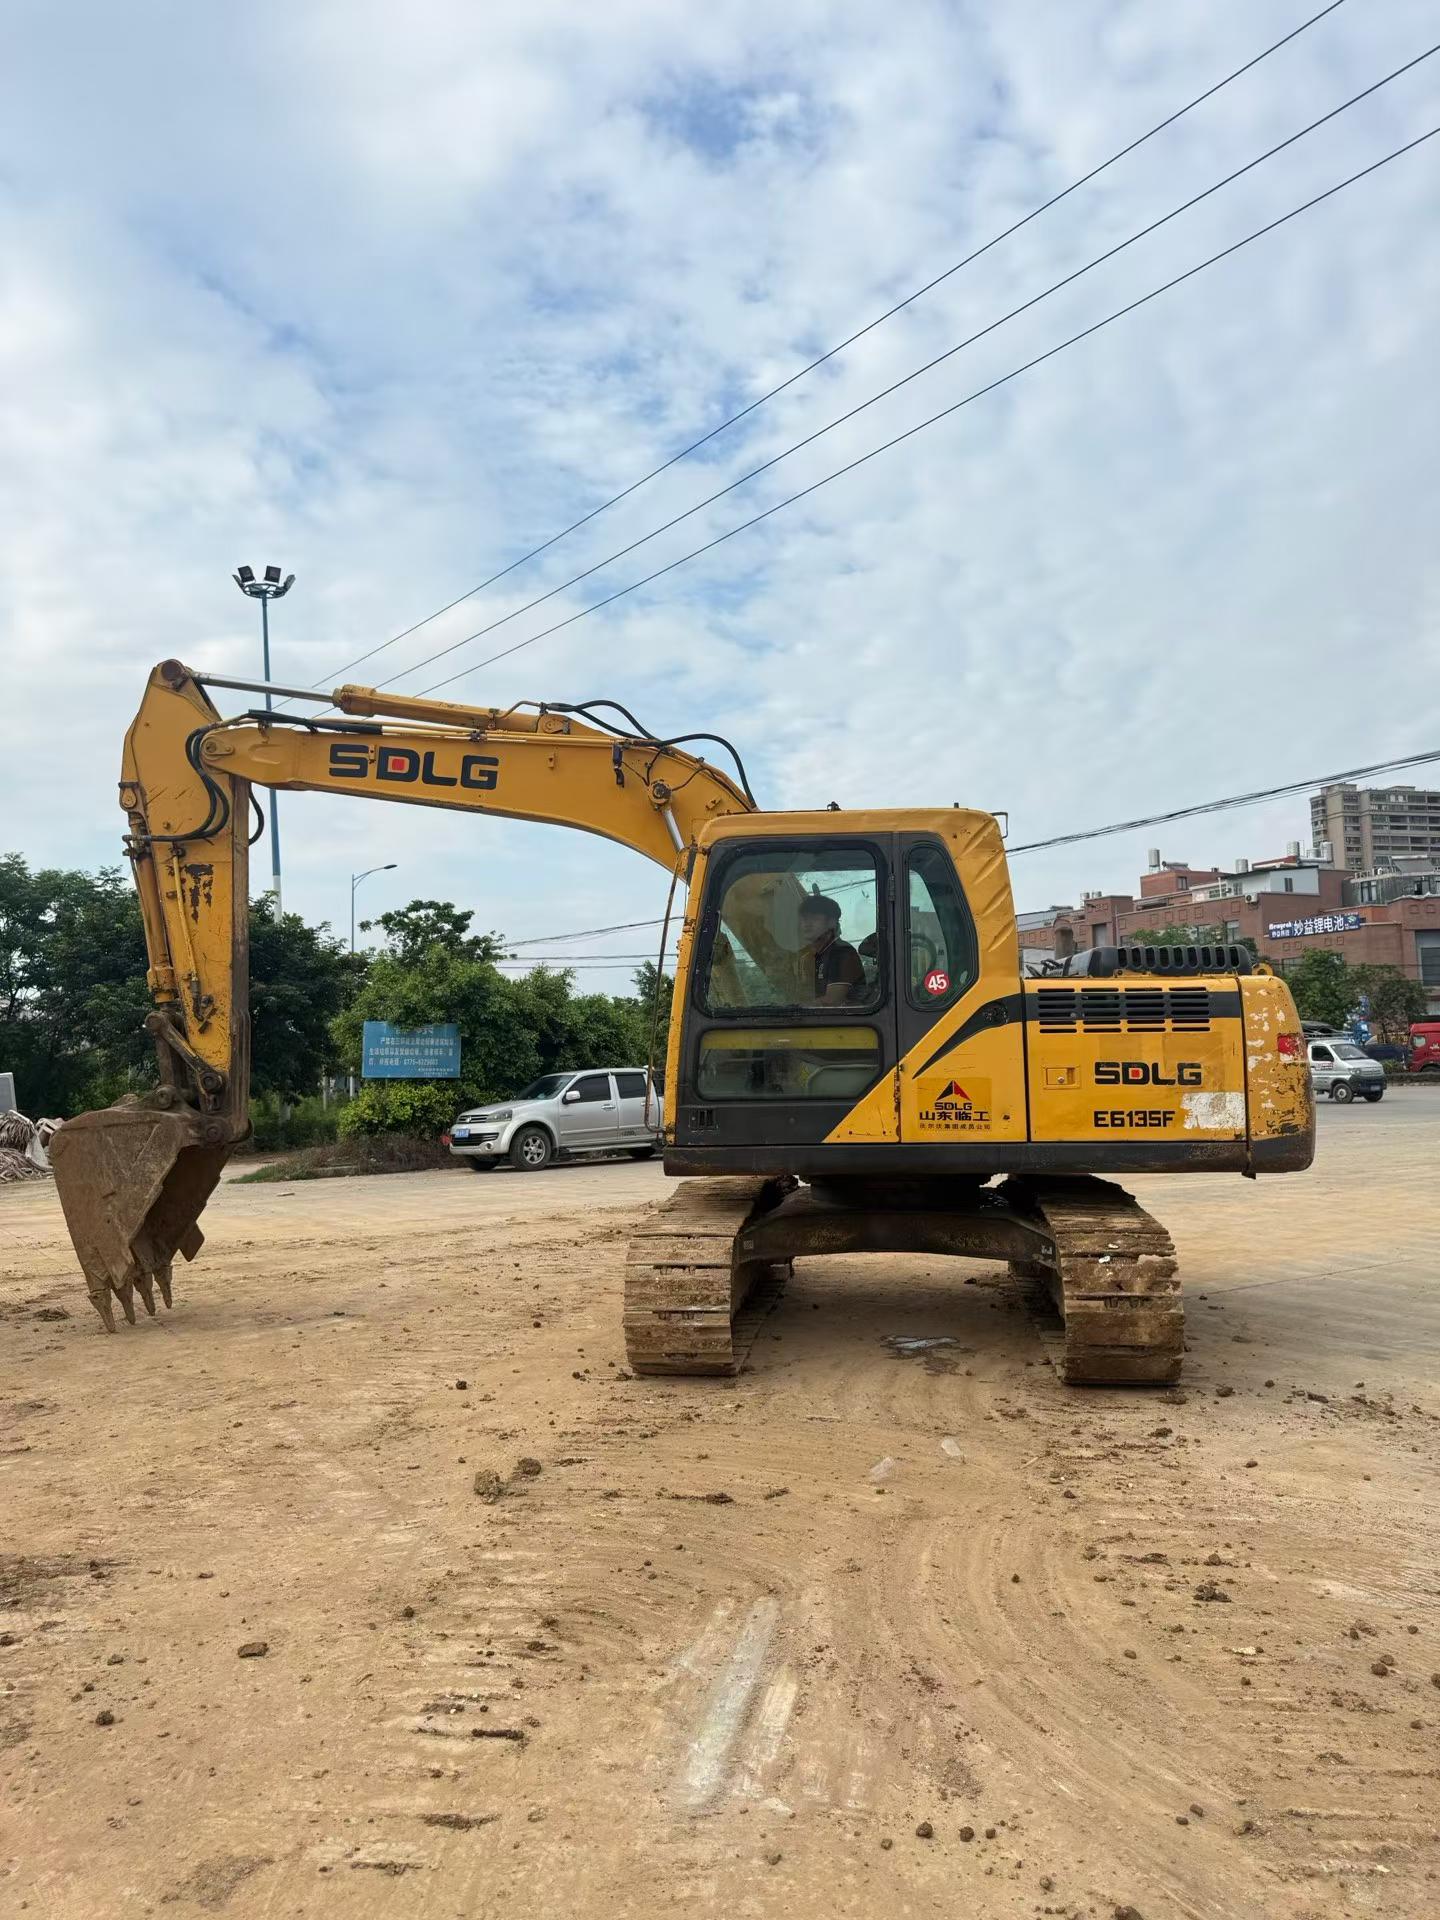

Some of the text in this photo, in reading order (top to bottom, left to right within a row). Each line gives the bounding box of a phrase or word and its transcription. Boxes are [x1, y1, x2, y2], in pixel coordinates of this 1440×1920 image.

[329, 743, 499, 790] SDLG
[1293, 915, 1344, 936] 妙益锂电池
[928, 974, 947, 990] 45
[1094, 1061, 1202, 1086] SDLG
[934, 1102, 972, 1111] SDLG
[919, 1110, 990, 1121] 山东临工
[1093, 1110, 1175, 1127] E6135F
